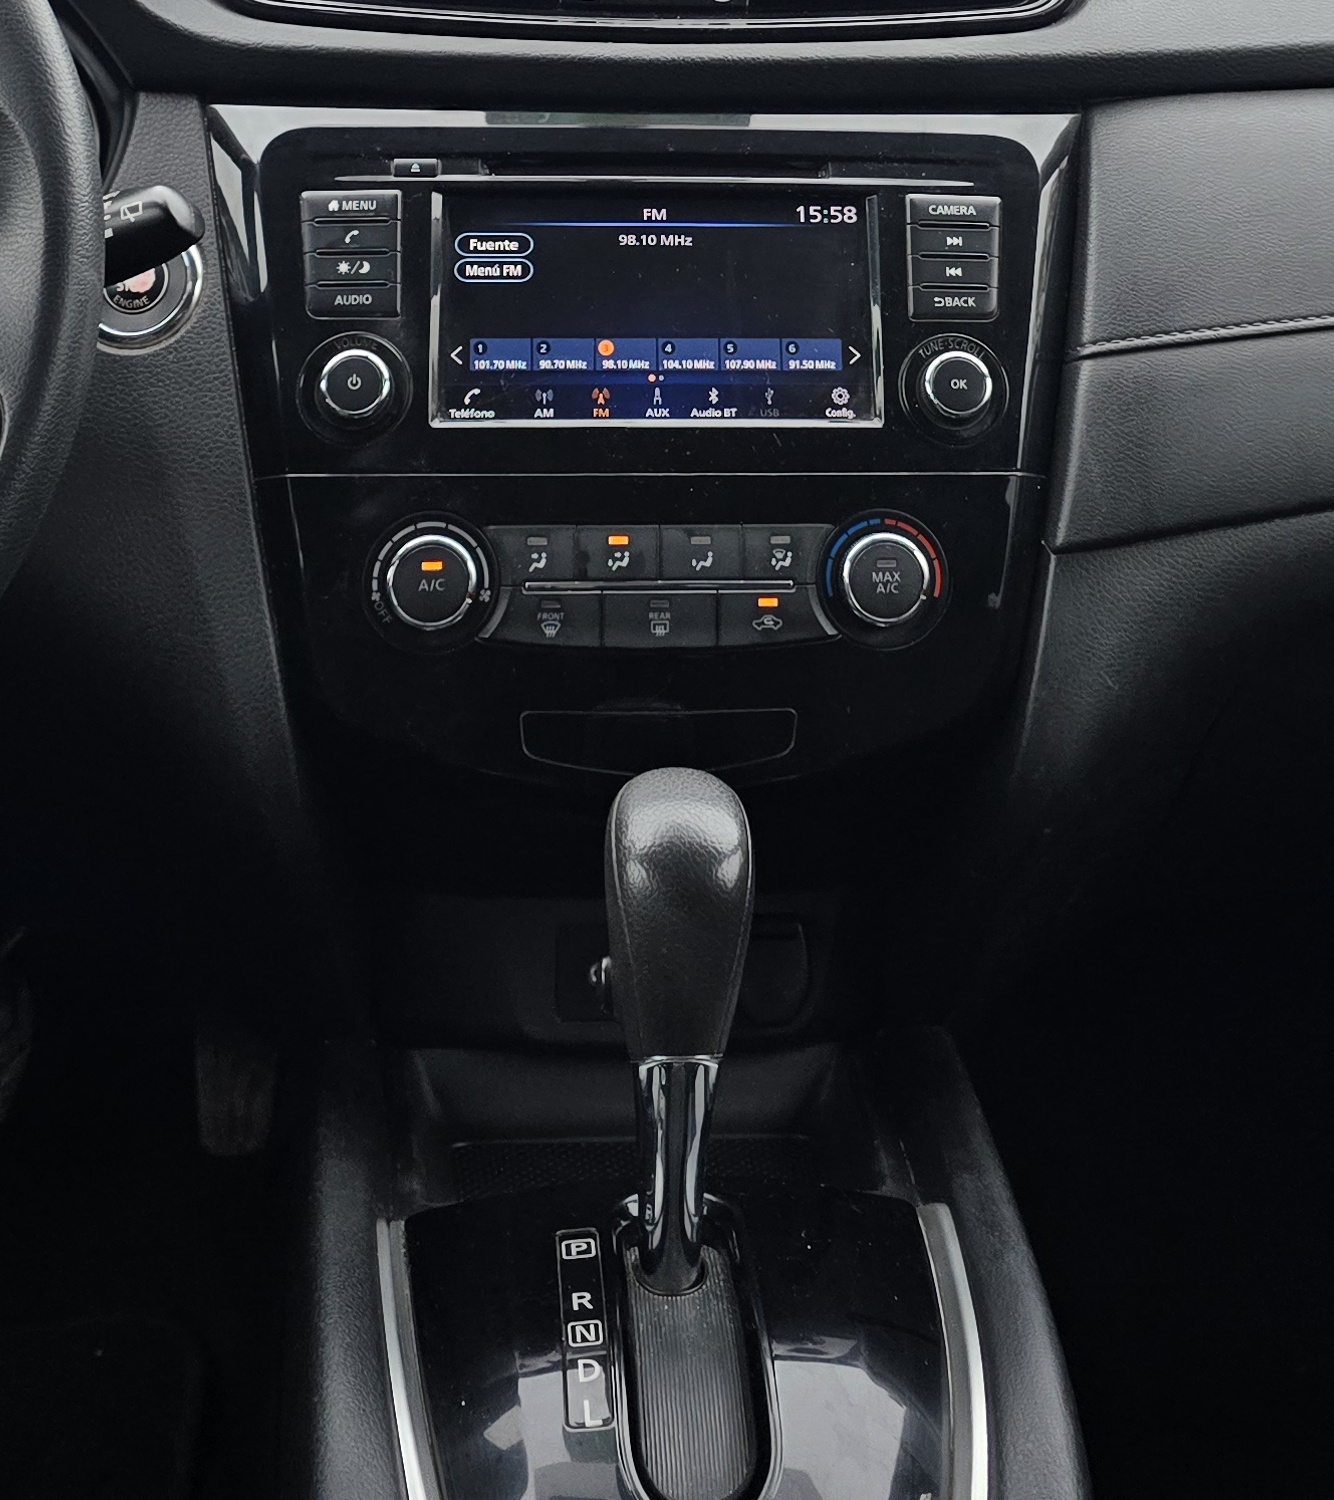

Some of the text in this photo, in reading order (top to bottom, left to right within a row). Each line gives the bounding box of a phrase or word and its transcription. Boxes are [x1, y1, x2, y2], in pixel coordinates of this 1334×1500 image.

[342, 200, 377, 211] MENU
[928, 204, 976, 216] CAMERA
[643, 209, 667, 221] FM
[796, 206, 858, 224] 15:58
[469, 238, 519, 251] Fuente
[618, 234, 693, 247] 98.10 MHz
[465, 263, 522, 277] Menú FM
[112, 294, 150, 309] ENGINE
[334, 294, 373, 305] AUDIO
[945, 296, 976, 308] BACK
[474, 360, 527, 370] 101.70 MHz
[539, 360, 587, 370] 90.70 MHz
[602, 360, 649, 370] 98.10 MHz
[662, 360, 715, 370] 104.10 MHz
[756, 360, 777, 370] MHz
[788, 360, 836, 370] 91.50 MHz
[950, 379, 967, 389] OK
[534, 408, 554, 418] AM
[593, 408, 610, 418] FM
[645, 408, 670, 418] AUX
[690, 408, 737, 418] Audio BT
[760, 408, 779, 418] USB
[825, 407, 856, 419] Config.
[872, 571, 901, 583] MAX
[418, 578, 446, 592] A/C
[876, 583, 899, 594] A/C
[373, 601, 393, 625] OFF
[537, 612, 565, 621] FRONT
[649, 611, 671, 621] REAR
[571, 1242, 588, 1257] P
[572, 1292, 593, 1311] R
[575, 1324, 596, 1343] N
[578, 1358, 601, 1383] D
[583, 1400, 603, 1427] L
